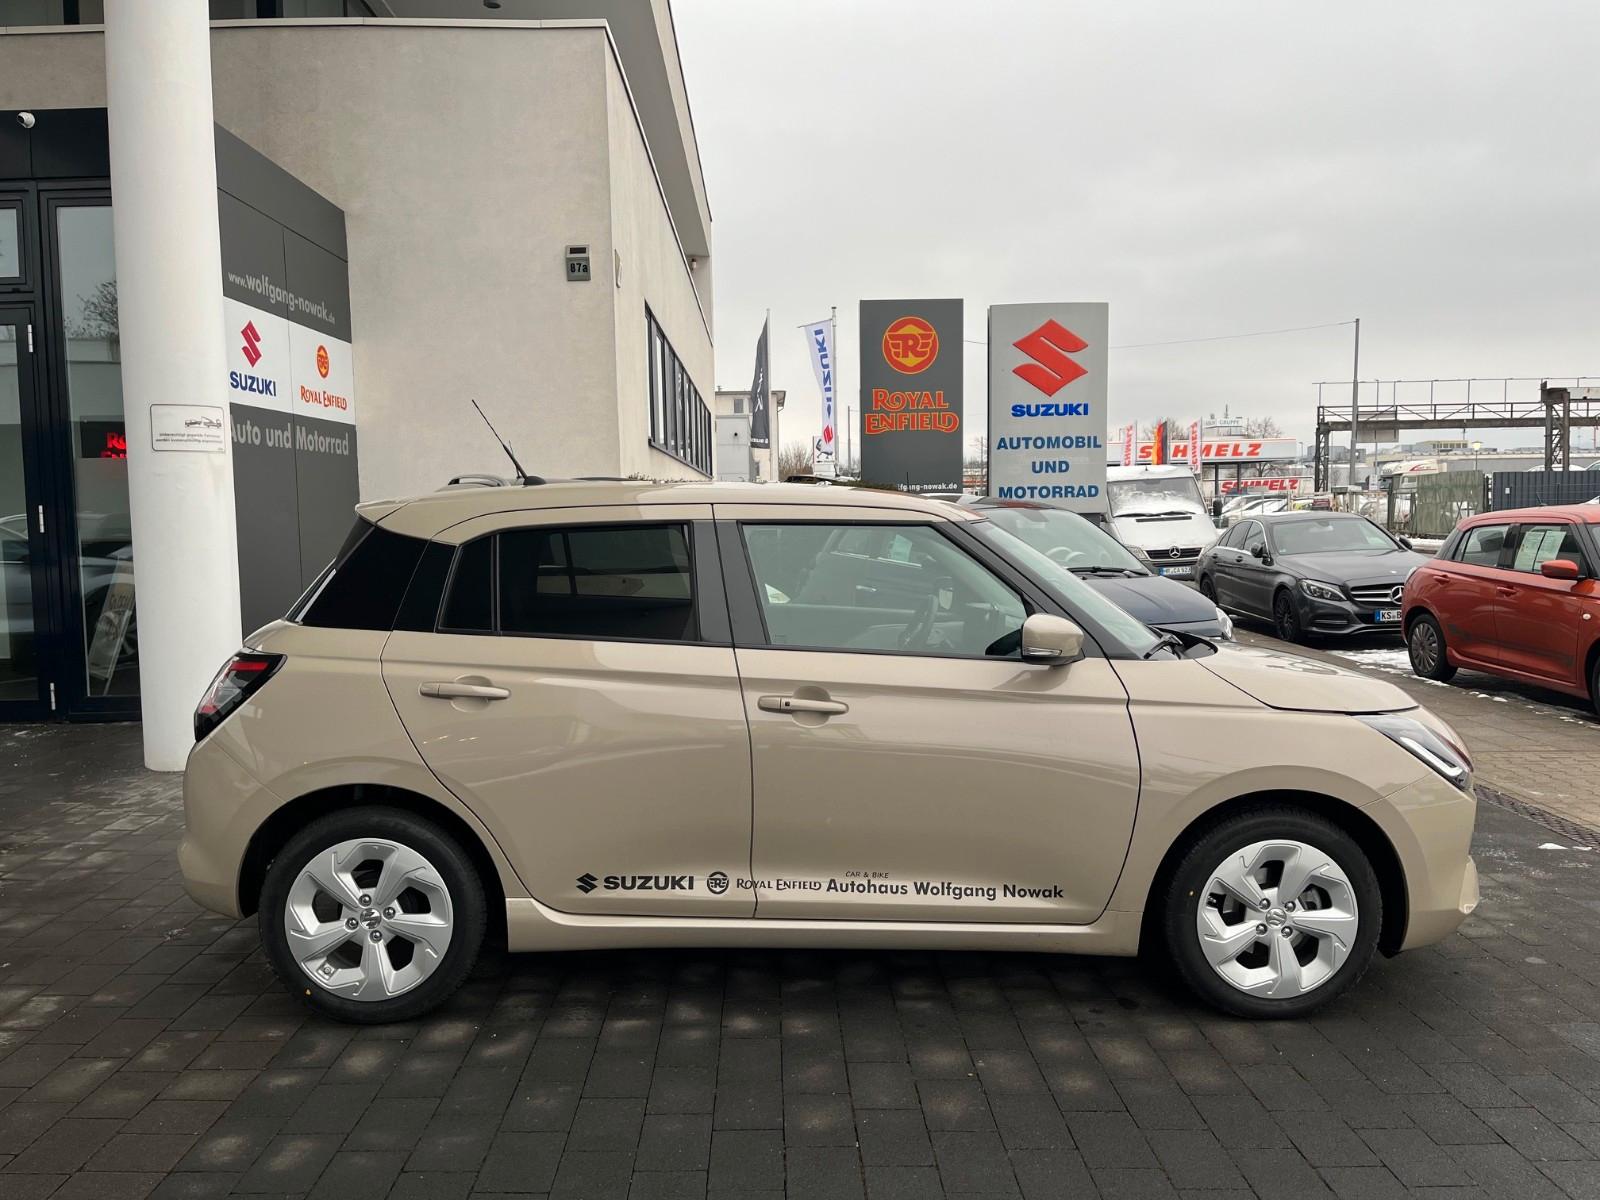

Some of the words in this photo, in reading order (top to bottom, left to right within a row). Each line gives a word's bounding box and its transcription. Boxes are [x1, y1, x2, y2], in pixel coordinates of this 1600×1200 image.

[228, 272, 336, 325] www.wolfgang-nowak.de
[229, 370, 277, 397] SUZUKI
[300, 385, 322, 405] ROYAL
[323, 391, 348, 410] ENFIELD
[872, 388, 950, 412] ROYAL
[1011, 403, 1089, 417] SUZUKI
[230, 414, 261, 446] Auto
[265, 422, 292, 449] und
[296, 425, 349, 456] Motorrad
[864, 411, 960, 435] ENFIELD
[997, 435, 1102, 450] AUTOMOBIL
[1138, 443, 1262, 459] SHMELZ
[1031, 460, 1070, 474] UND
[998, 485, 1099, 499] MOTORRAD
[1381, 611, 1392, 620] KS
[603, 875, 695, 890] SUZUKI
[736, 878, 773, 890] ROYAL
[776, 879, 822, 891] ENFIELD
[826, 878, 908, 895] Autohaus
[913, 881, 997, 900] Wolfgang
[1003, 884, 1064, 899] Nowak
